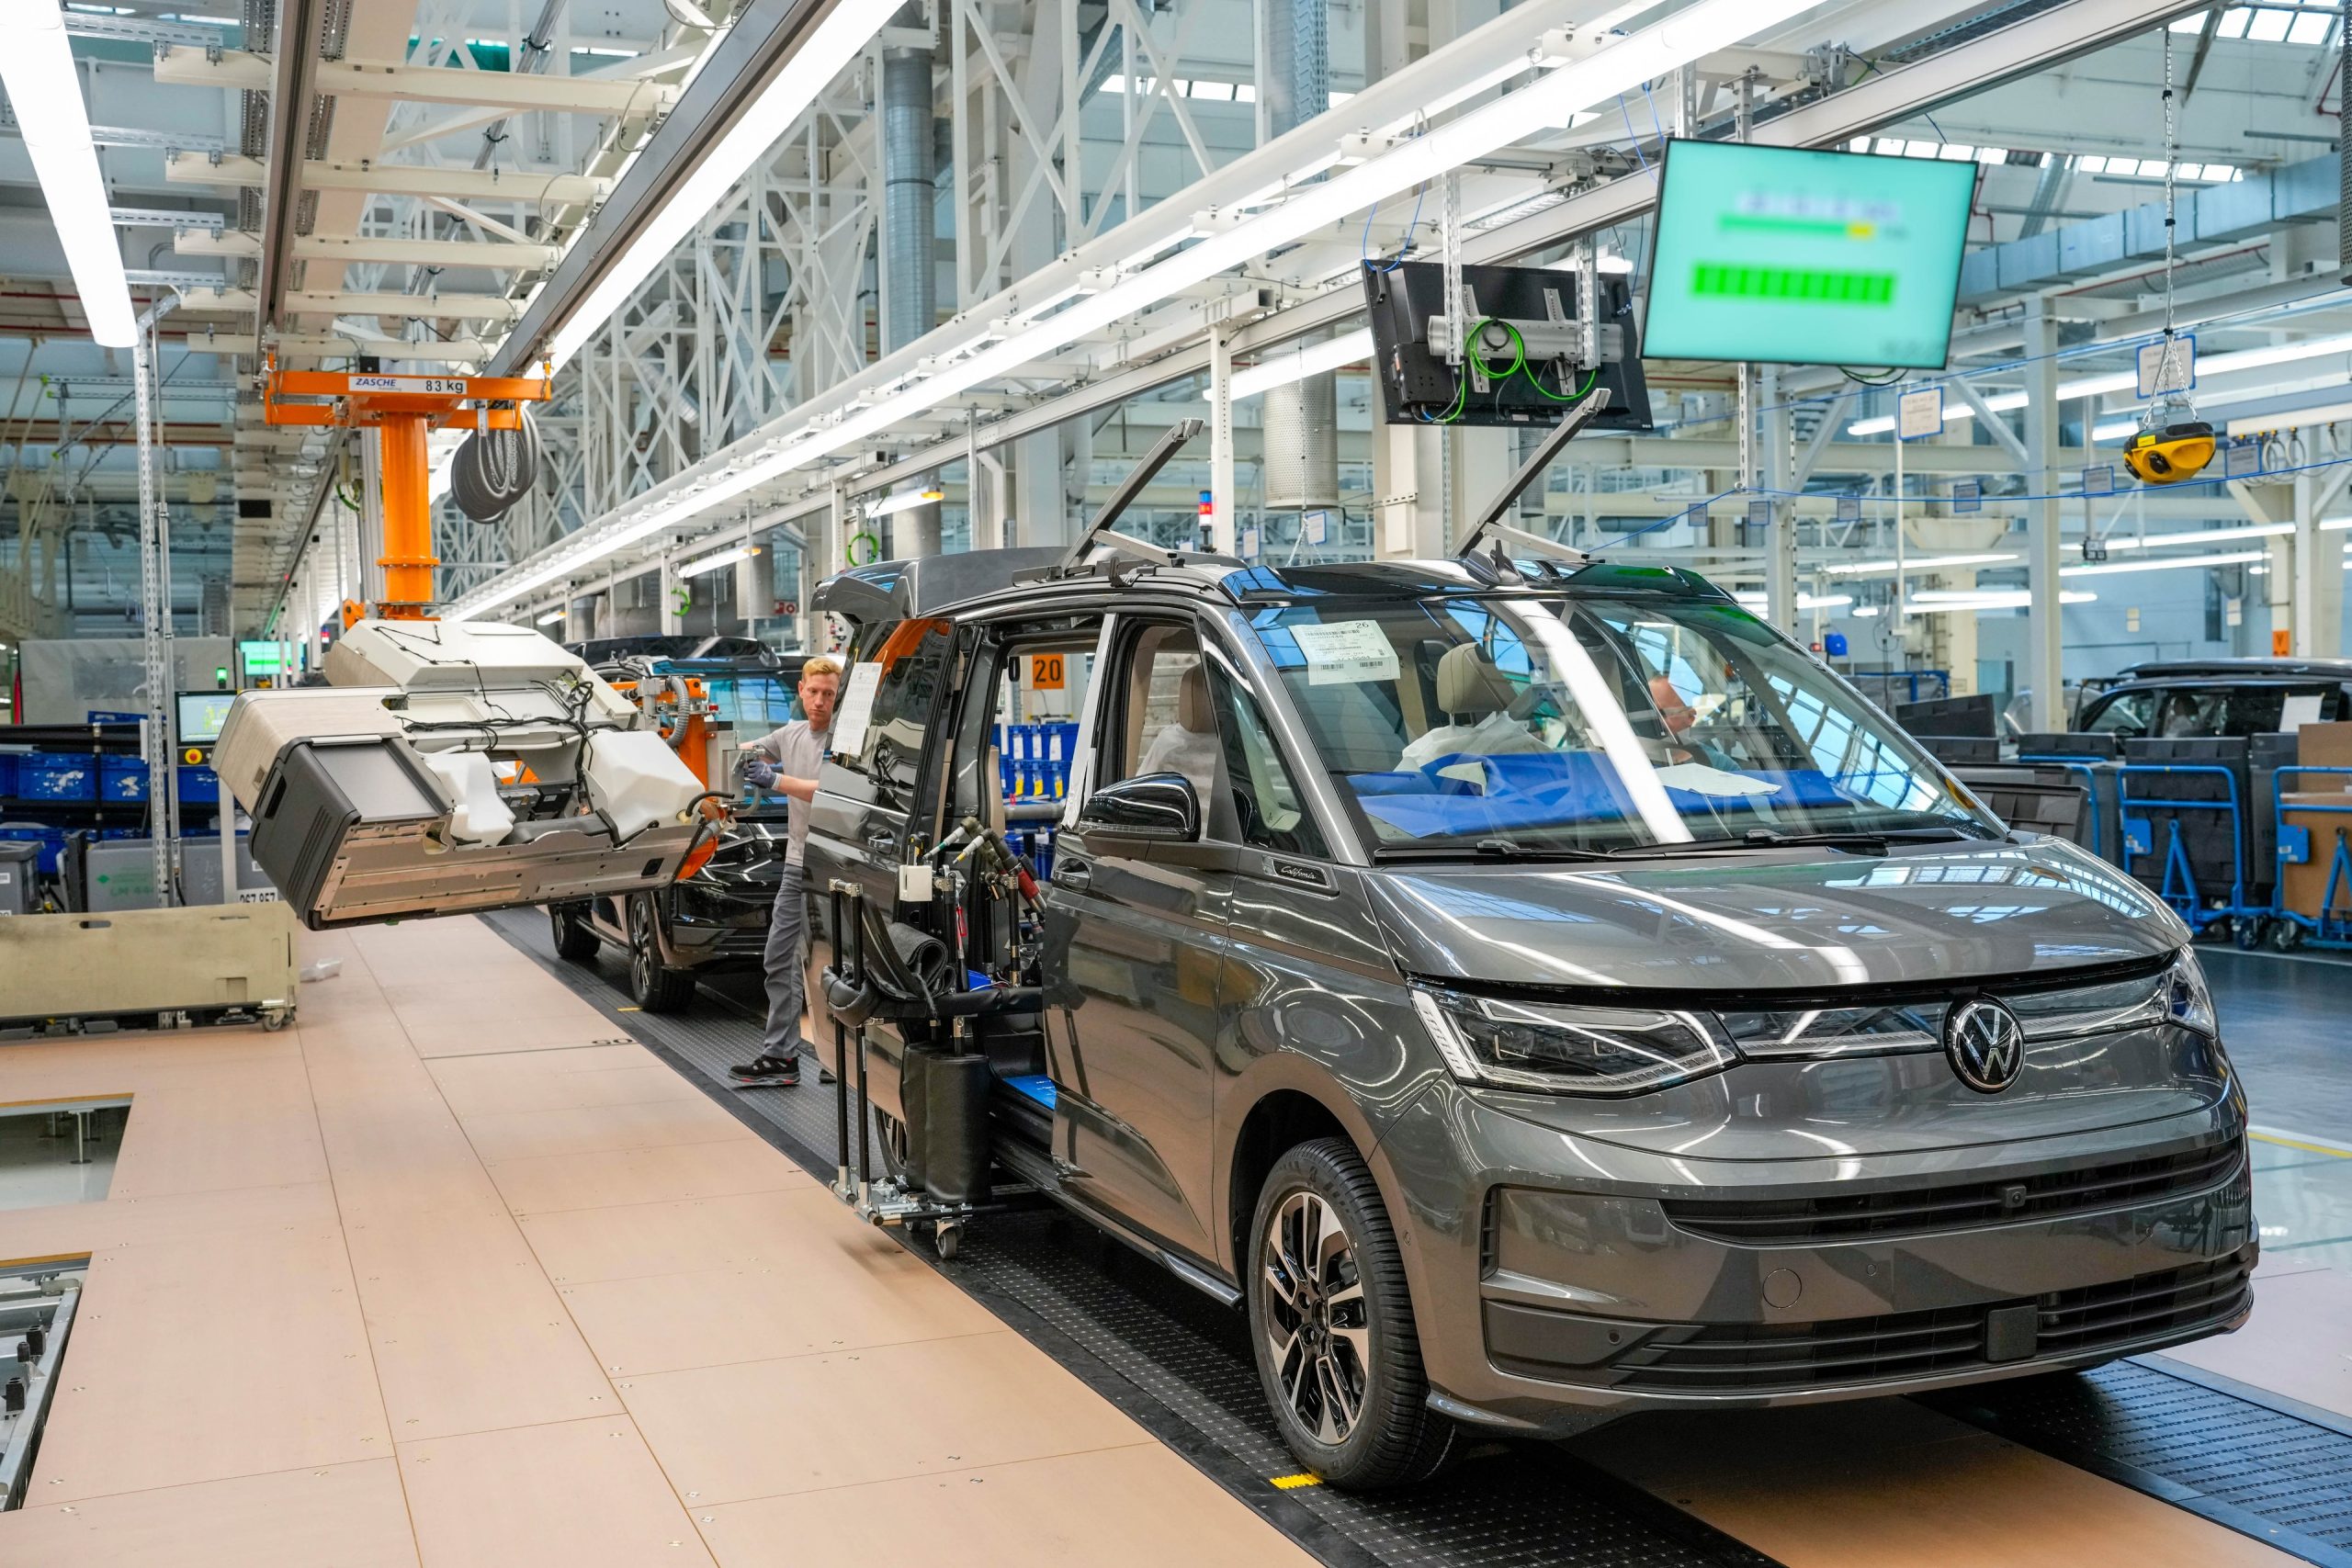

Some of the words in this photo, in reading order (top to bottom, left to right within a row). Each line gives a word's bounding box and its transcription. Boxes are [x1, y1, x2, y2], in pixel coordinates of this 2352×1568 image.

[356, 378, 397, 387] ZASCHE
[425, 379, 442, 392] 83
[447, 379, 464, 393] kg
[1355, 621, 1369, 629] 26
[1035, 659, 1061, 682] 20
[1281, 866, 1317, 879] California
[1955, 1005, 2020, 1085] VW
